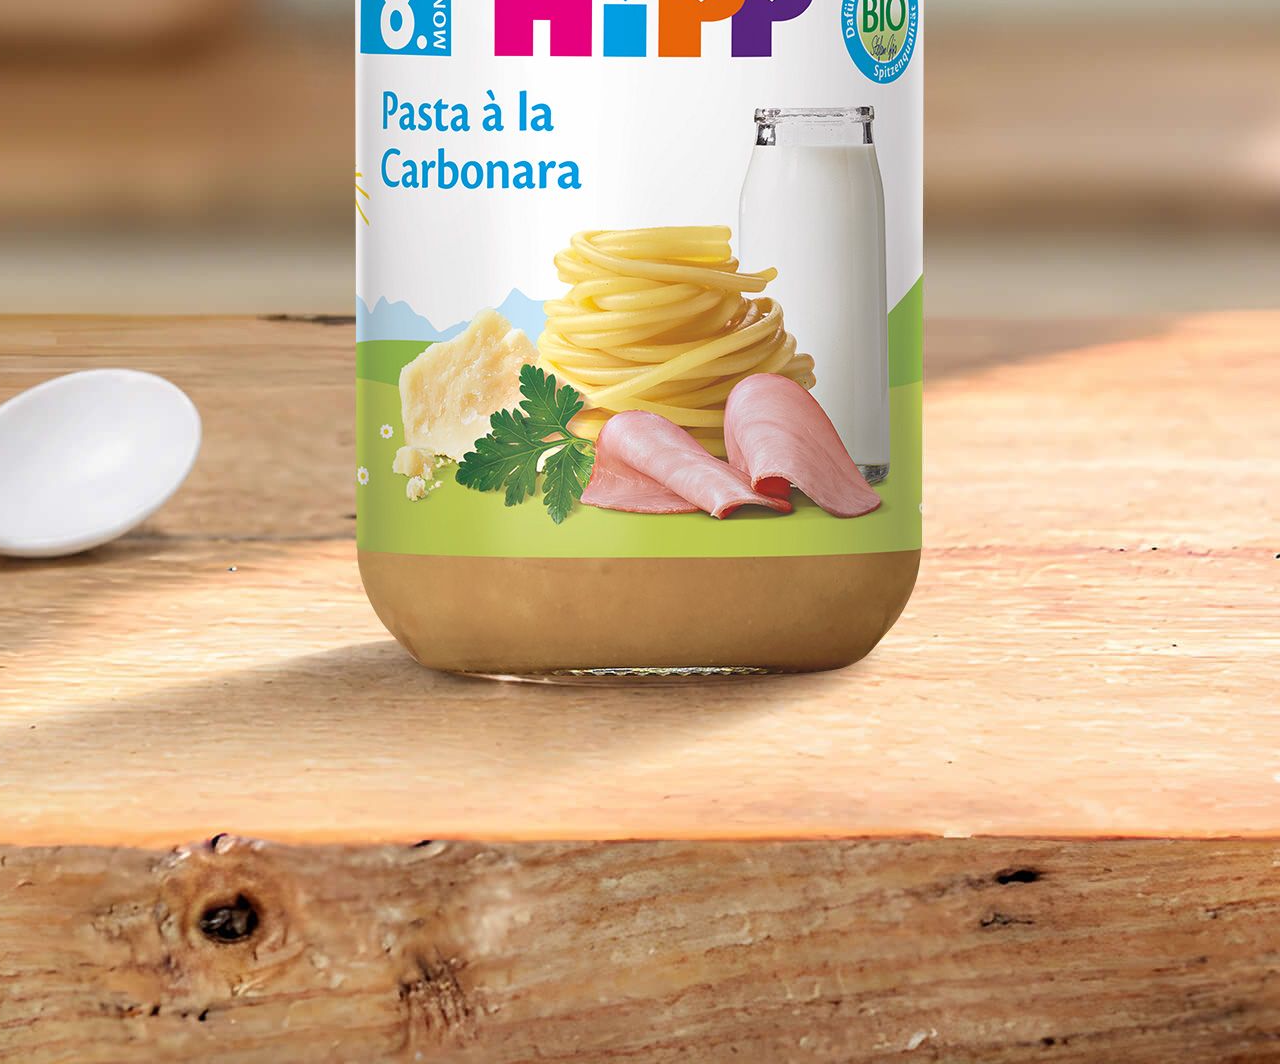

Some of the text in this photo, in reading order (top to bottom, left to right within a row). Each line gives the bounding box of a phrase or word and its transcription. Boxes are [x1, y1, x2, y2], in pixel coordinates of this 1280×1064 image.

[382, 89, 555, 132] Pasta à la
[381, 147, 583, 190] Carbonara
